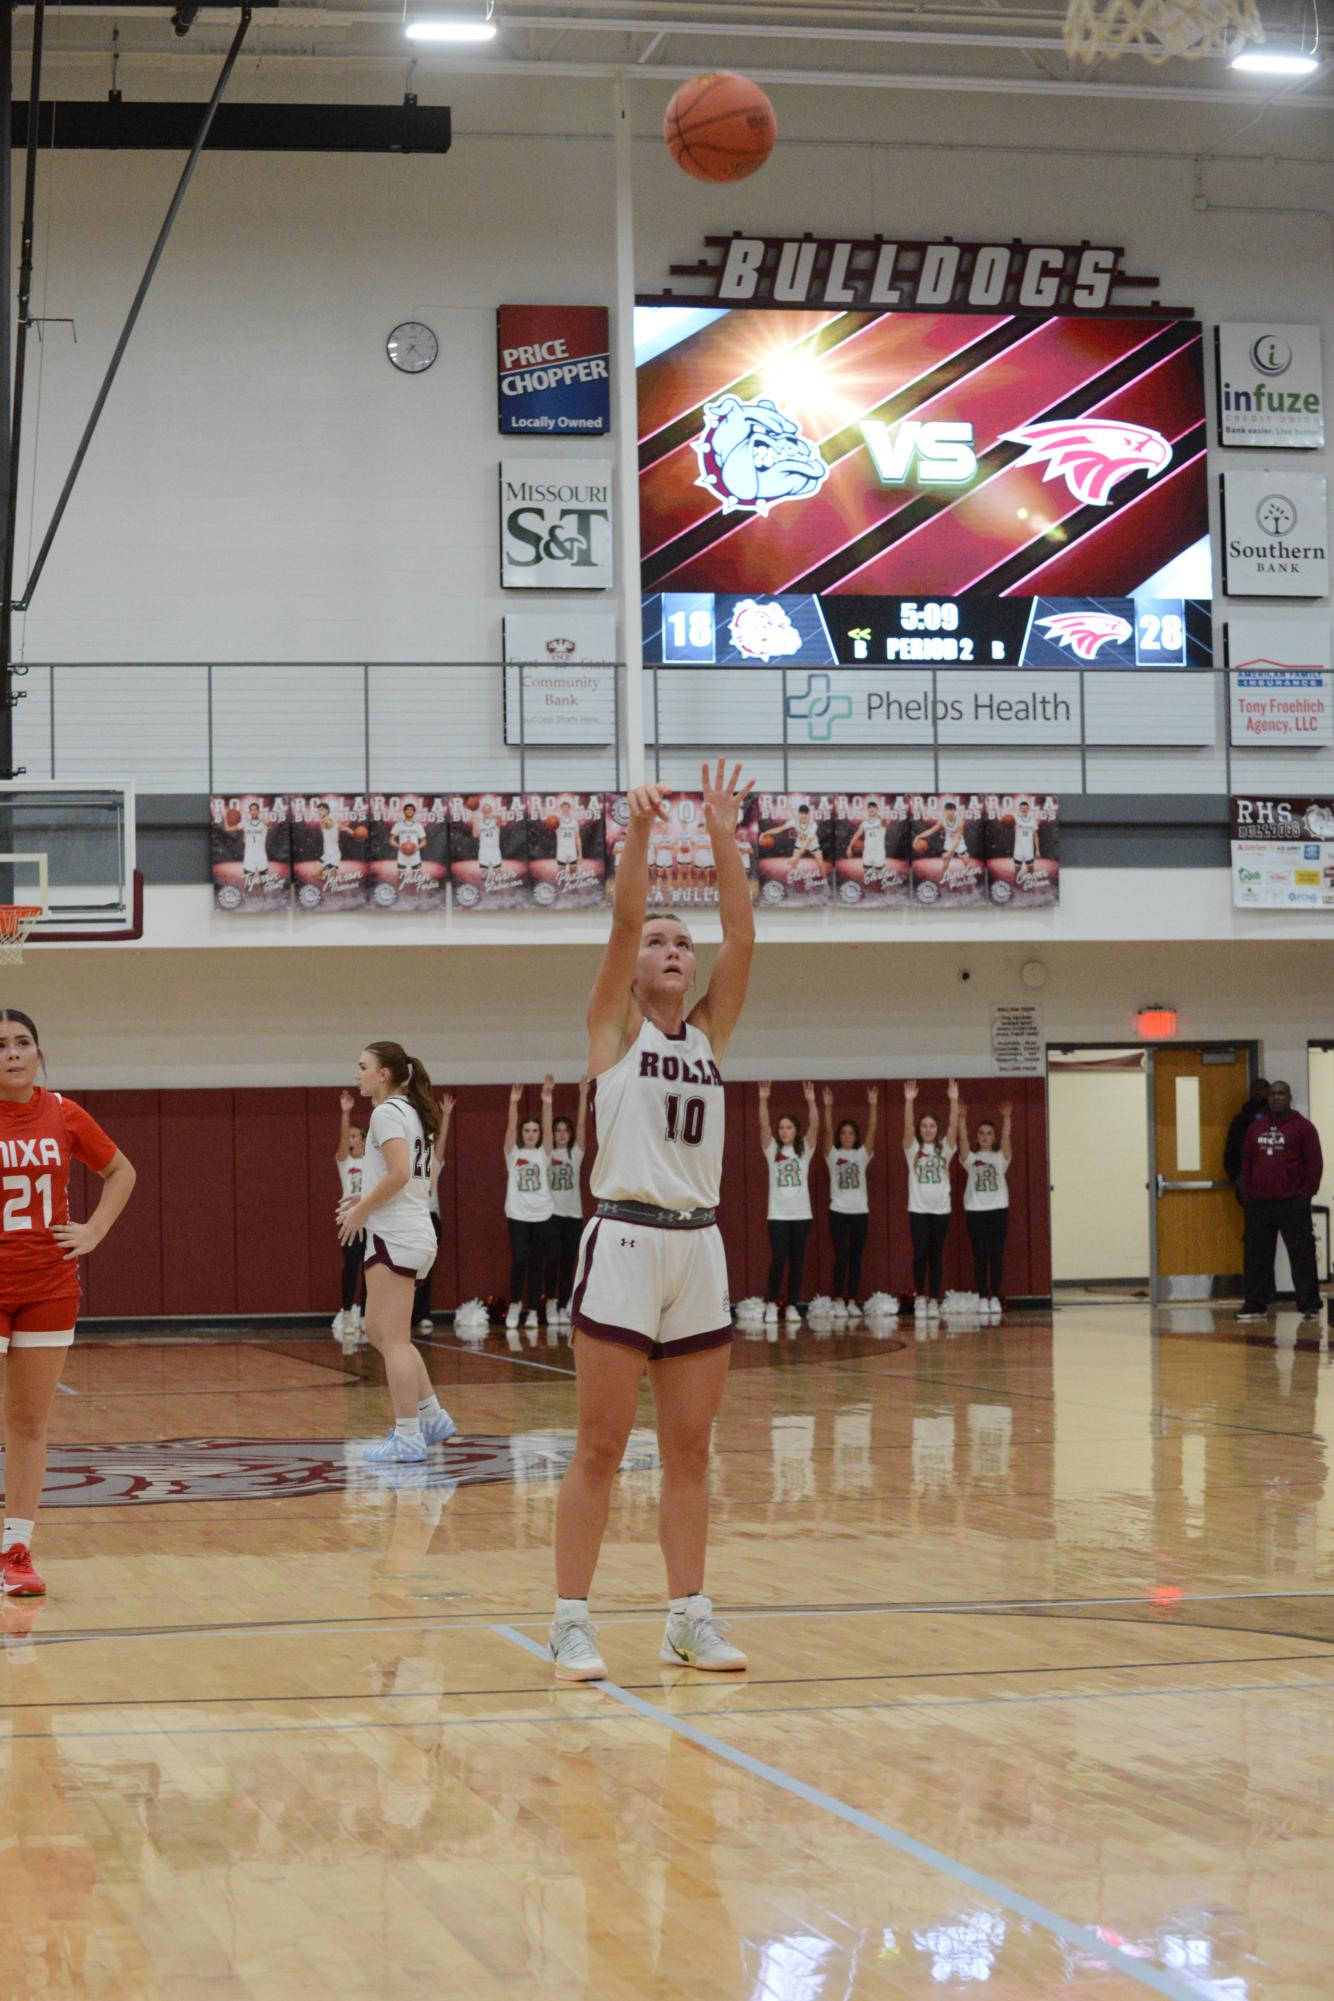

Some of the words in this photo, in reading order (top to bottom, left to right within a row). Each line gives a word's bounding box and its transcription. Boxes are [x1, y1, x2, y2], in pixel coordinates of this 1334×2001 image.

[718, 239, 1118, 309] BULLDOGS
[502, 339, 569, 369] PRICE
[501, 360, 609, 396] CHOPPER
[1224, 383, 1320, 414] infuze
[511, 416, 556, 430] Locally
[558, 416, 603, 428] Owned
[1226, 426, 1246, 434] Bank
[858, 420, 978, 484] VS
[506, 482, 608, 502] MISSOURI
[505, 506, 609, 568] S&T
[1229, 541, 1326, 560] Southern
[1256, 563, 1300, 573] BANK
[668, 610, 713, 648] 18
[900, 602, 959, 631] 5:09
[1139, 614, 1183, 651] 28
[886, 638, 958, 661] PERIOD
[959, 638, 974, 661] 2
[521, 675, 601, 692] Community
[544, 694, 578, 706] Bank
[867, 691, 963, 727] Phelps
[973, 692, 1071, 721] Health
[1238, 698, 1267, 717] Tony
[1269, 698, 1325, 713] Froehlich
[1246, 716, 1292, 735] Agency,
[1295, 716, 1318, 732] LLC
[213, 797, 287, 812] ROLA
[295, 796, 367, 811] ROLA
[374, 796, 446, 811] ROLA
[452, 797, 525, 811] RLA
[530, 796, 602, 811] ROLA
[838, 796, 908, 810] ROLA
[988, 796, 1057, 811] ROLA
[1237, 800, 1293, 824] RHS
[664, 1092, 706, 1148] 10
[413, 1136, 432, 1179] 22
[917, 1156, 942, 1184] R
[518, 1166, 542, 1192] R
[777, 1159, 802, 1188] R
[838, 1163, 861, 1190] R
[975, 1164, 1000, 1192] R
[2, 1173, 53, 1232] 21
